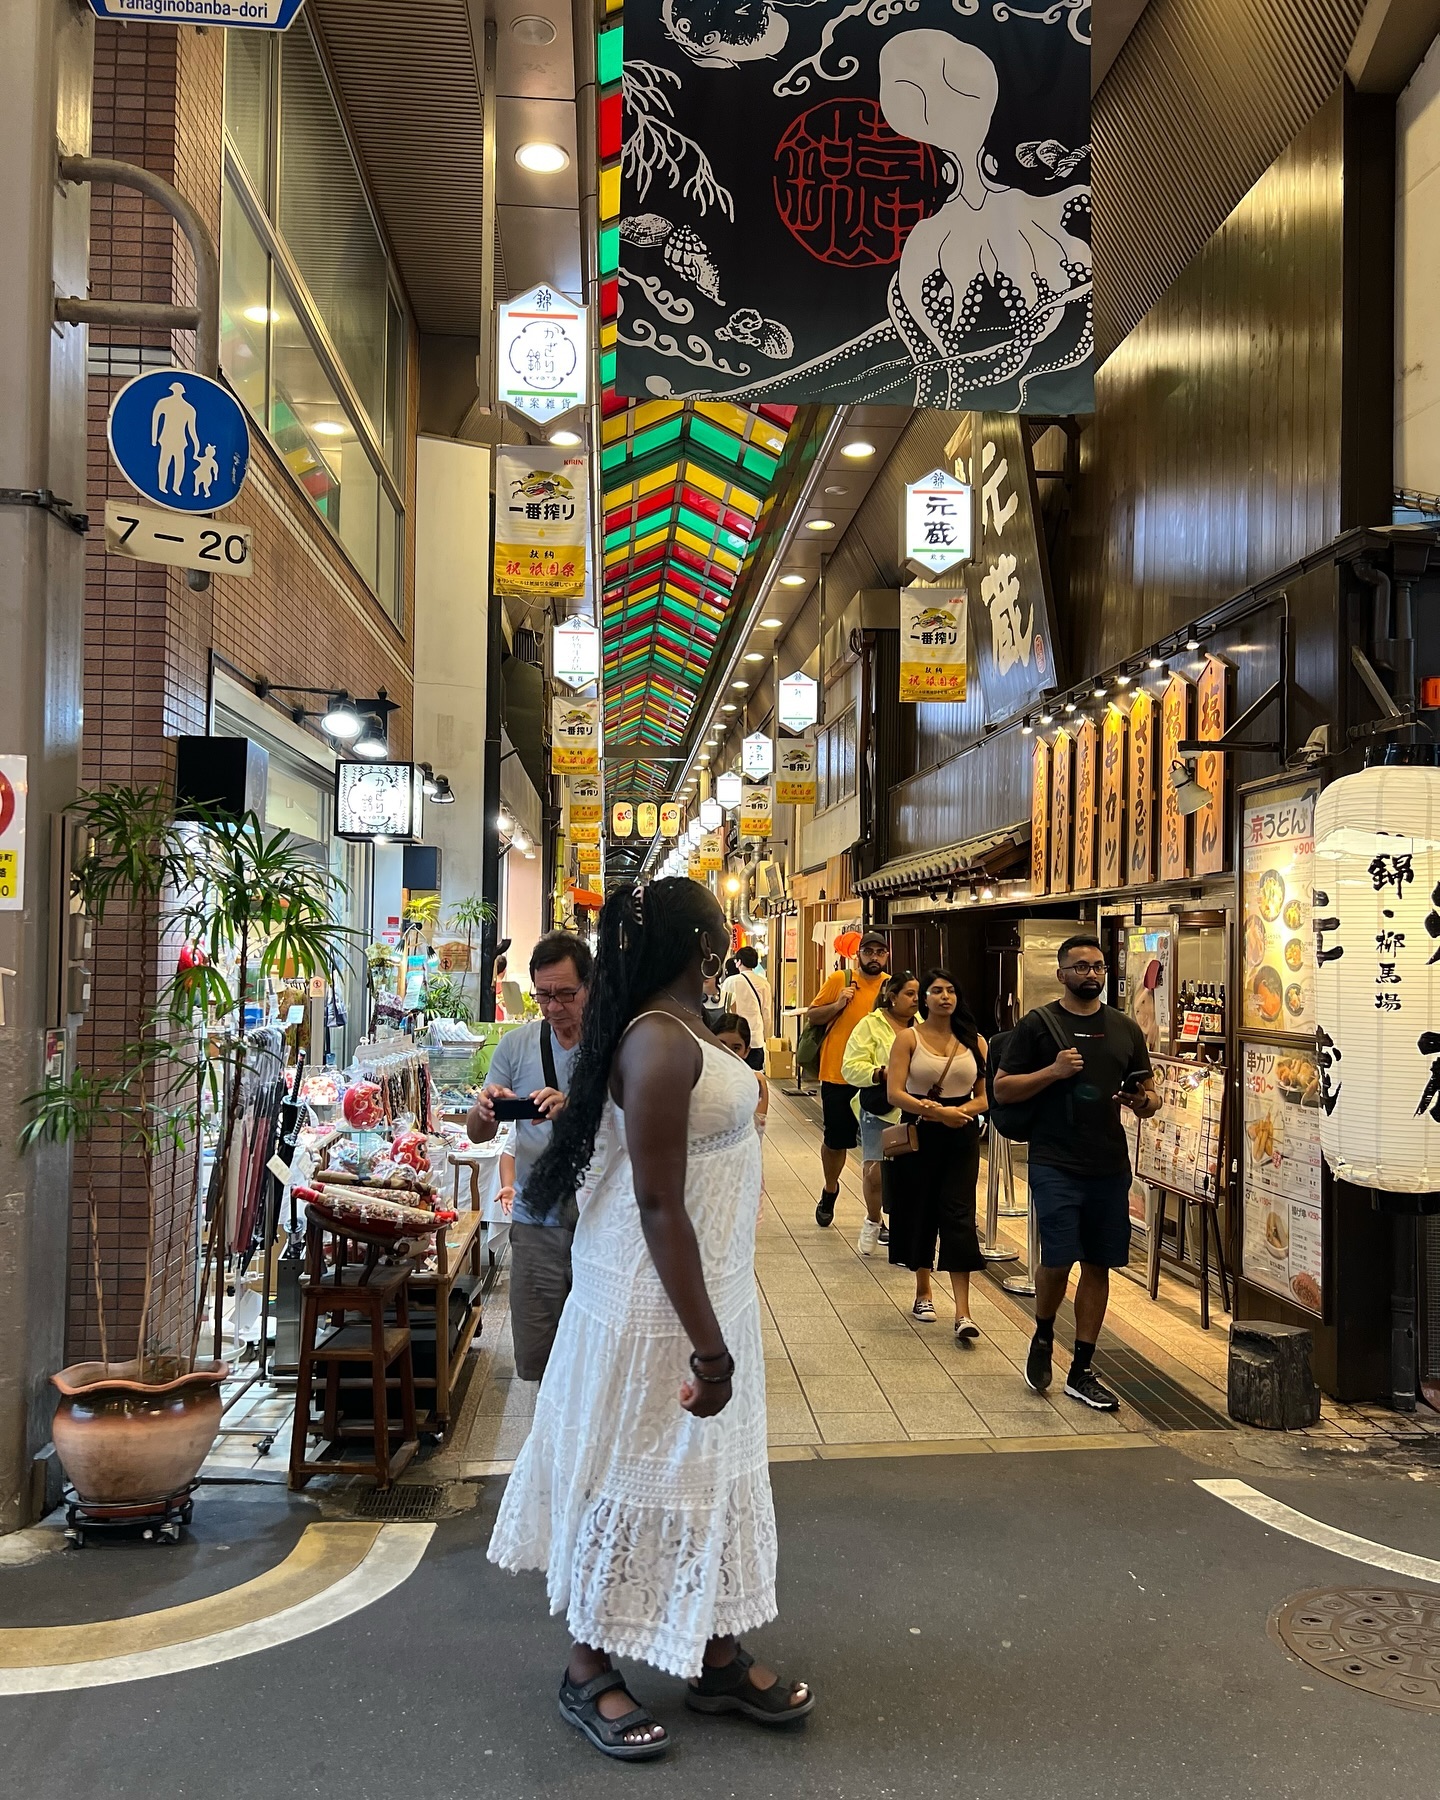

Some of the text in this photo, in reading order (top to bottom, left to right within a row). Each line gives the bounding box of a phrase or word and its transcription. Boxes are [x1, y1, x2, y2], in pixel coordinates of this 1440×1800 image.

[509, 503, 575, 521] 一番搾り
[924, 496, 958, 546] 元蔵
[116, 516, 140, 544] 7
[199, 530, 247, 564] 20
[910, 632, 957, 645] 一番搾り
[559, 726, 592, 735] 一番搾り
[782, 763, 810, 771] 一番搾り
[1251, 808, 1306, 843] 京うどん
[1247, 1050, 1275, 1074] 串カツ
